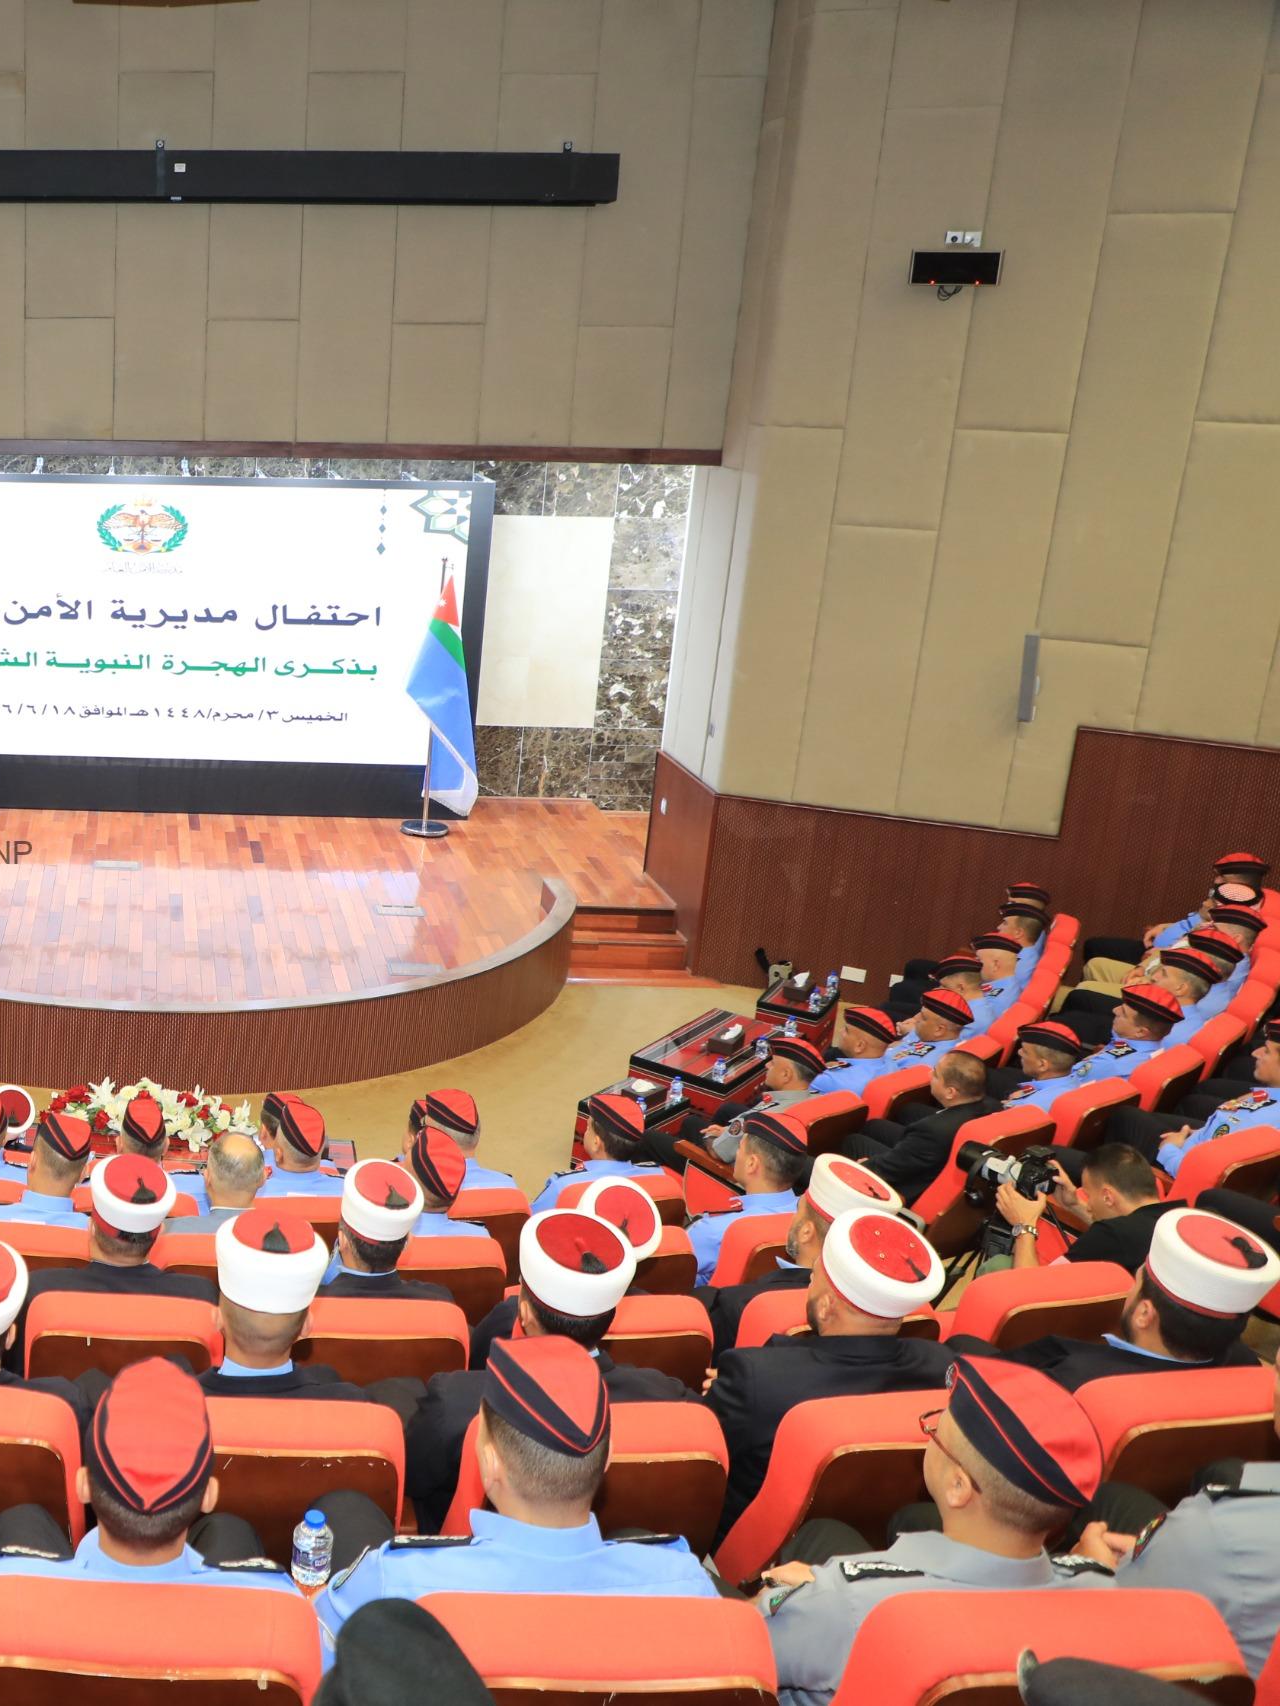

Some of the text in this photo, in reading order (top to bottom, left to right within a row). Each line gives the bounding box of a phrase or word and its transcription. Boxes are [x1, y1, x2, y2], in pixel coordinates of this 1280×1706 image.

[4, 593, 92, 625] الأمن
[111, 600, 237, 629] مديرية
[255, 605, 380, 630] احتفال
[46, 652, 150, 674] النبوية
[162, 655, 265, 677] الهجرة
[274, 659, 377, 680] بذكرى
[80, 704, 127, 719] الموافق
[282, 711, 348, 724] الخميس
